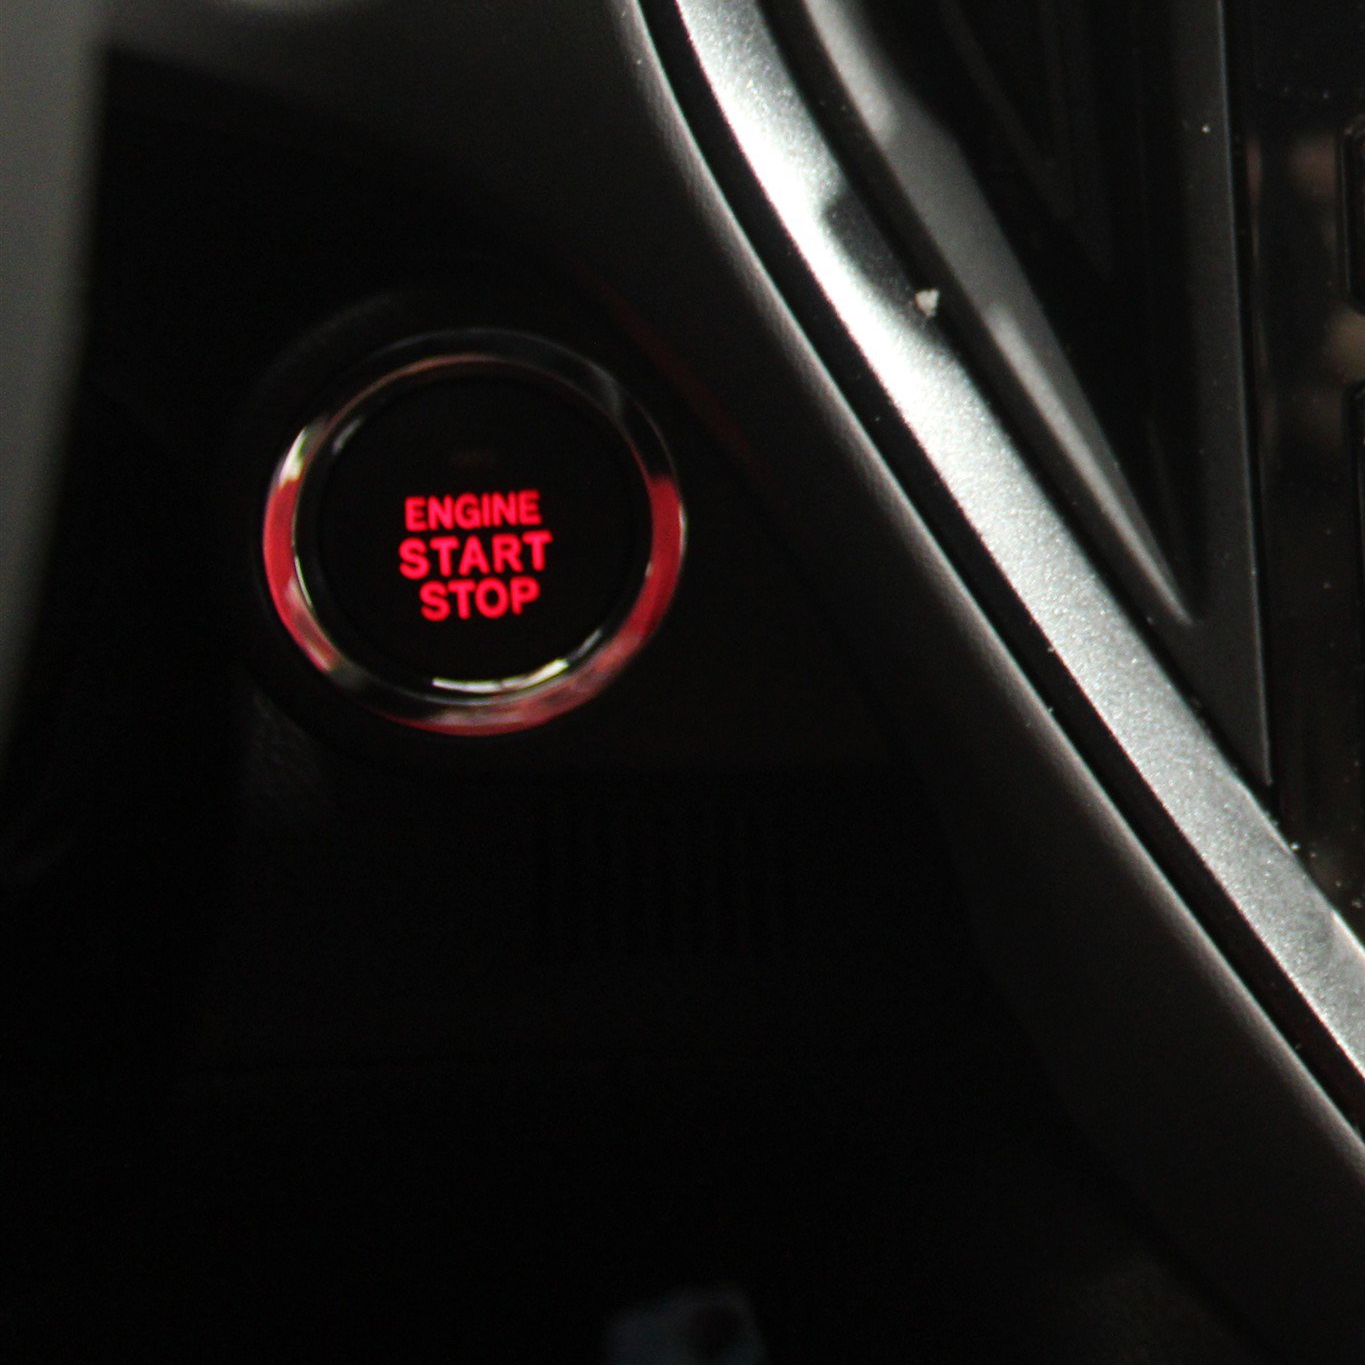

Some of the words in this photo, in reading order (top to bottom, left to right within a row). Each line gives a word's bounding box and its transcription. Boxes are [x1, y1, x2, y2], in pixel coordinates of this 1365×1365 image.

[404, 489, 543, 532] ENGINE
[398, 530, 553, 580] START
[419, 575, 541, 622] STOP
